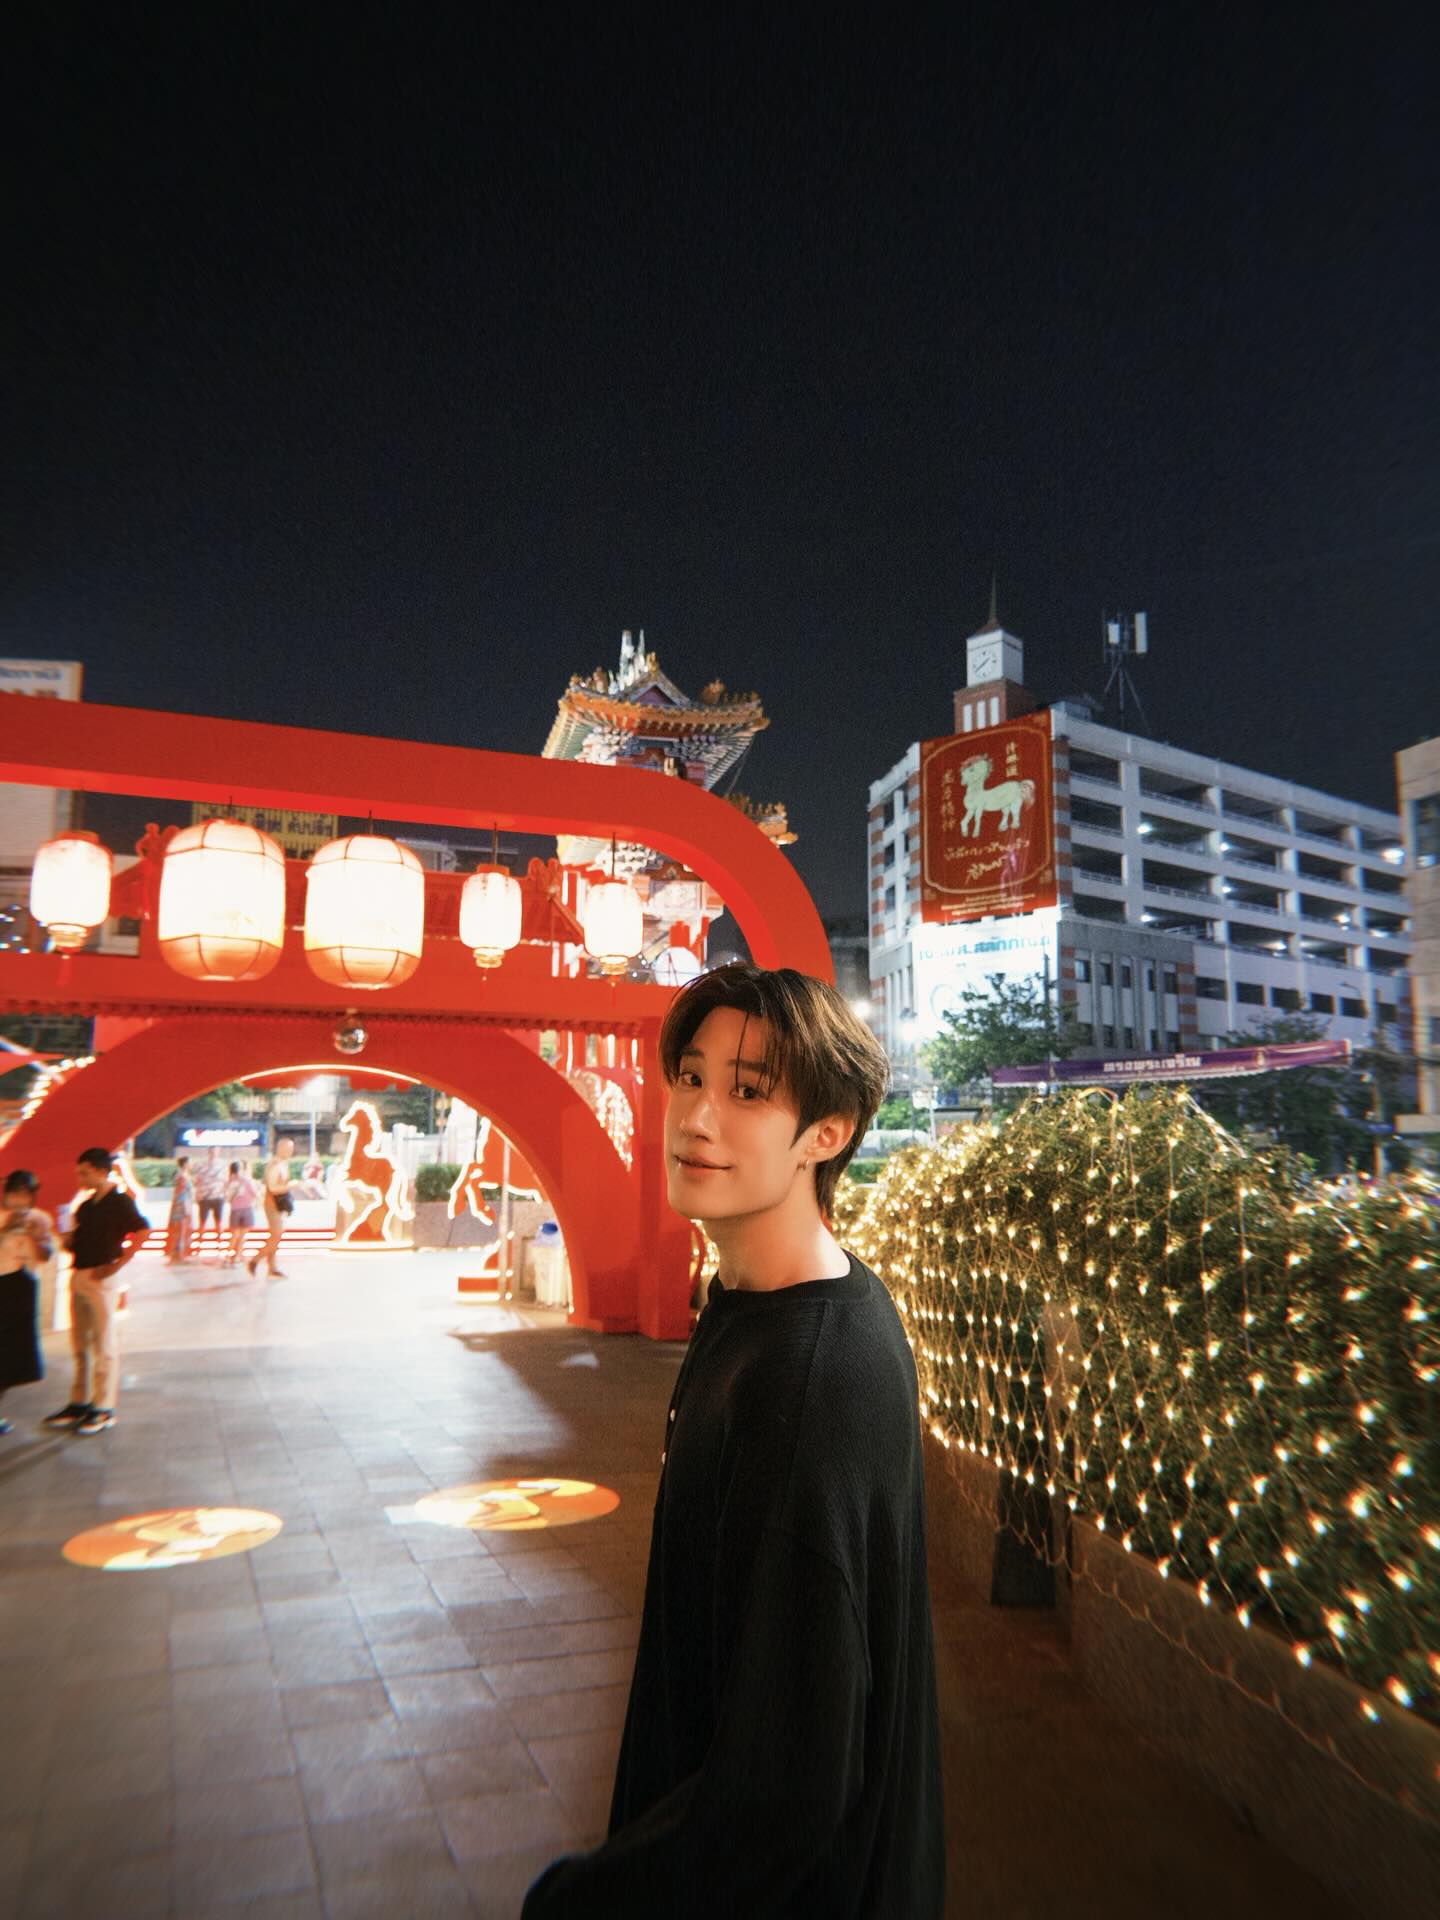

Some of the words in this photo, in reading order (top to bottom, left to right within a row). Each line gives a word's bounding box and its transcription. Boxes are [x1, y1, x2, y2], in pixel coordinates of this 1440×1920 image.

[1103, 1053, 1201, 1072] ทรงพระเจริญ
